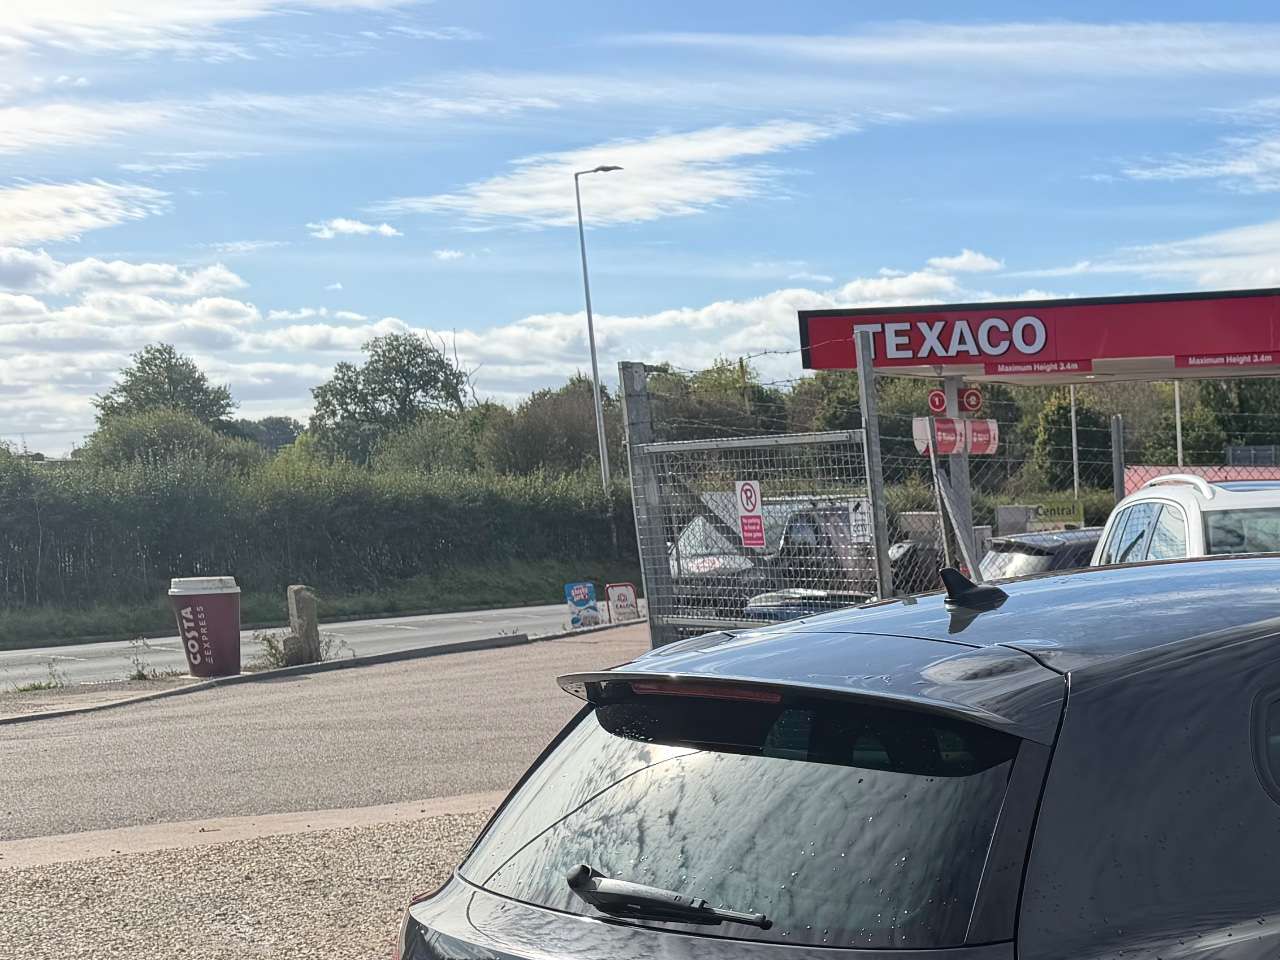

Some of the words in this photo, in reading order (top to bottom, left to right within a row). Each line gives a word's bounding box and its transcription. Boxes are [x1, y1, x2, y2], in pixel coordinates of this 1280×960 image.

[853, 315, 1047, 359] TEXACO
[997, 364, 1032, 373] Maximum
[1033, 363, 1058, 373] Height
[1059, 362, 1079, 371] 3.4m
[1188, 356, 1225, 365] Maximum
[1226, 355, 1252, 365] Height
[1252, 354, 1273, 363] 3.4m
[1036, 502, 1076, 517] Central
[181, 606, 202, 665] COSTA
[196, 606, 212, 656] EXPRESS
